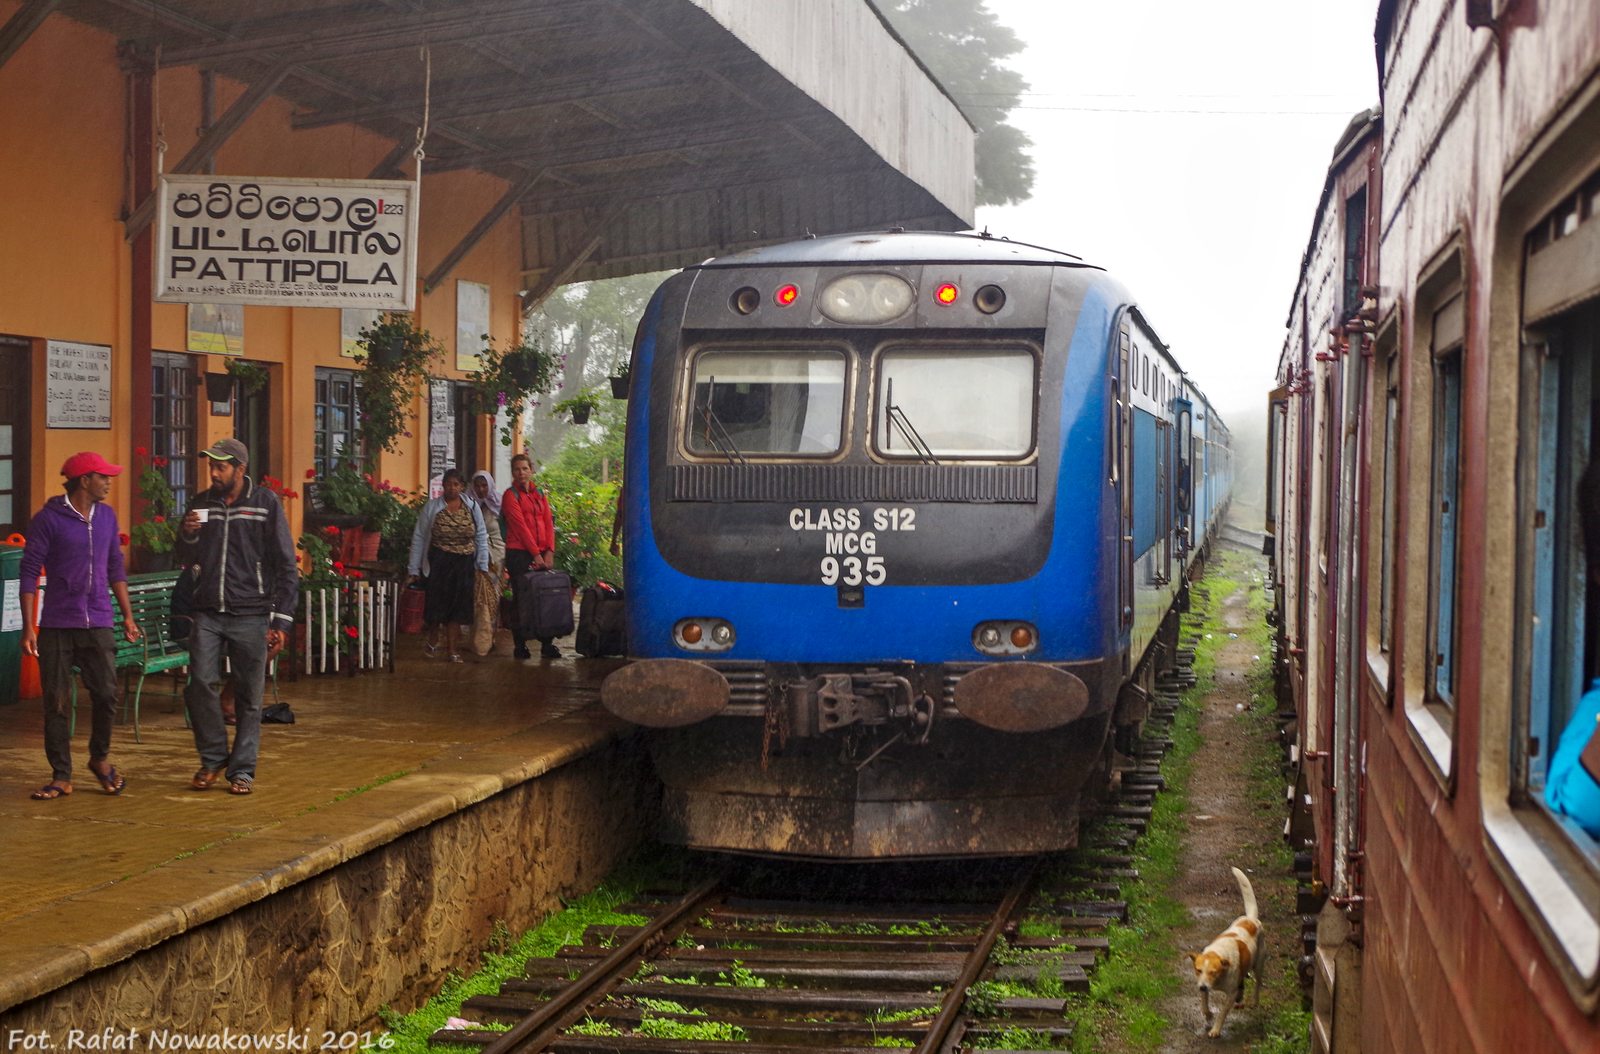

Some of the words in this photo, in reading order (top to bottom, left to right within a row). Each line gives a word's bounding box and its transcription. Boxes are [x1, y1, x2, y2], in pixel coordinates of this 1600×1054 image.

[384, 204, 404, 215] 223
[172, 226, 402, 256] பட்டிபொல
[171, 256, 399, 286] PATTIPOLA
[789, 507, 861, 531] CLASS
[873, 507, 916, 531] S12
[825, 531, 877, 555] MCG
[820, 556, 887, 586] 935
